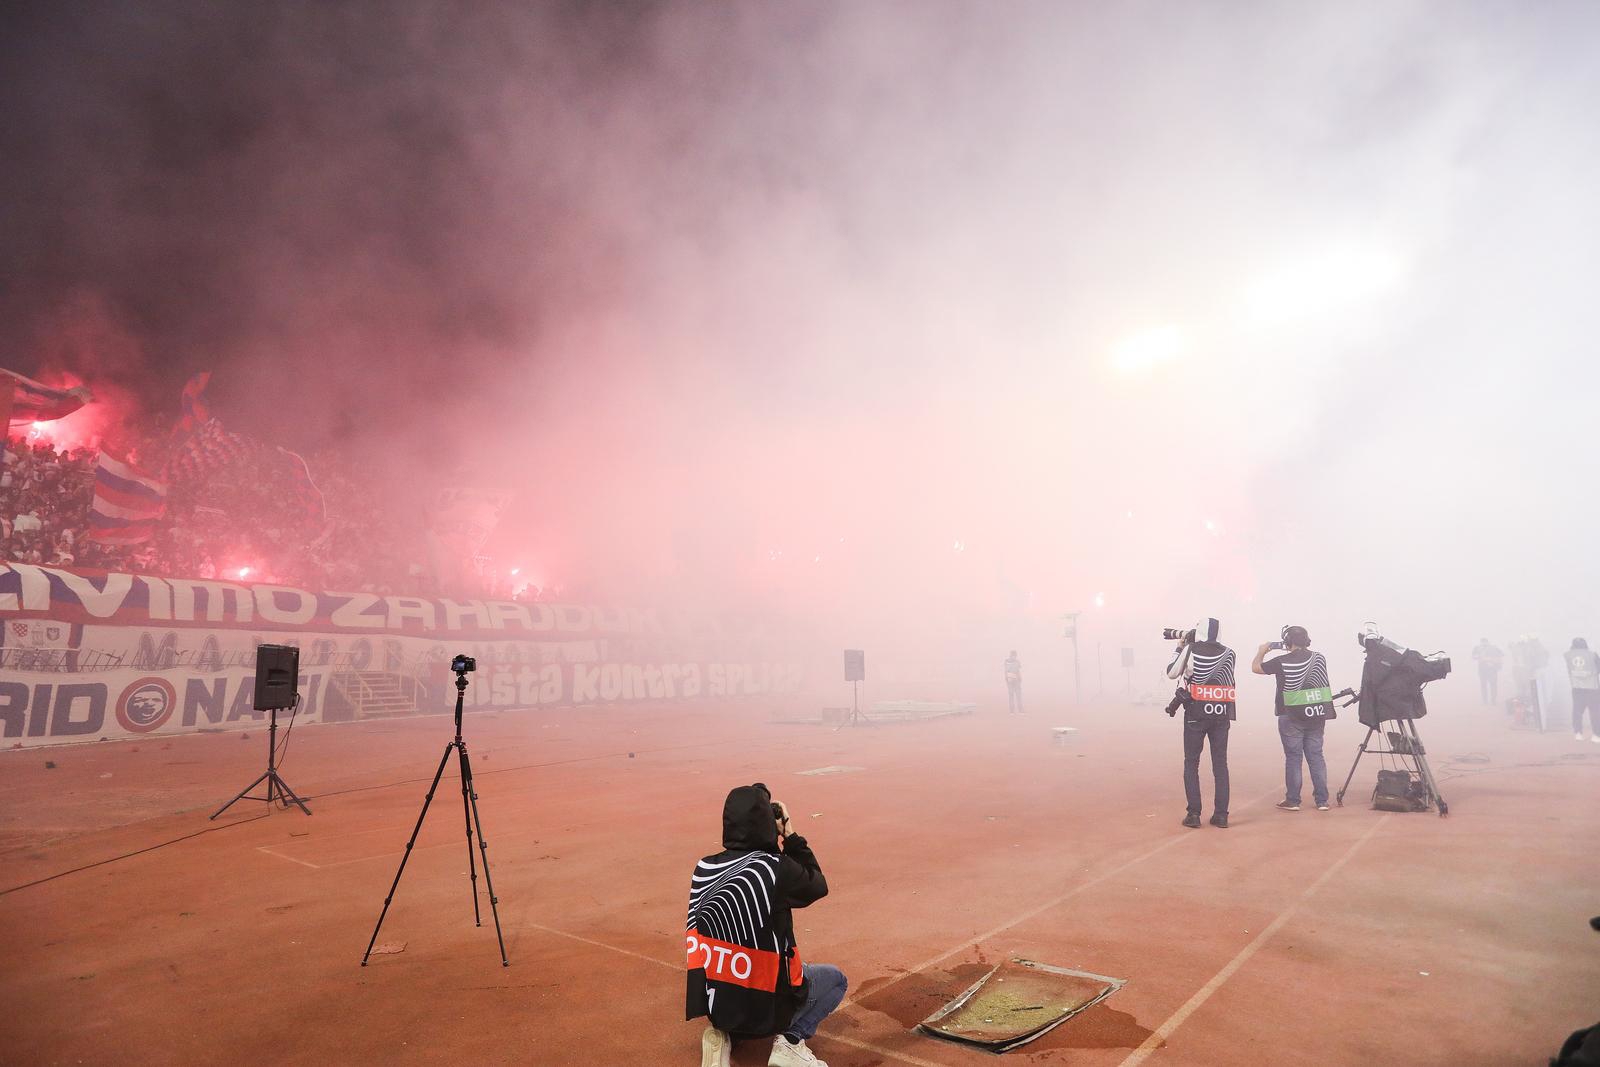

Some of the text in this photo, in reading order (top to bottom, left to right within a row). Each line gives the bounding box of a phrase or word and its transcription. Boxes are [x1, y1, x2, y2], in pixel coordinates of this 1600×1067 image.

[0, 561, 317, 624] IVIMO
[324, 590, 436, 630] ZA
[1197, 687, 1235, 699] PHOTO
[1305, 690, 1322, 702] HE
[1204, 703, 1227, 715] 001
[1304, 705, 1325, 717] 012
